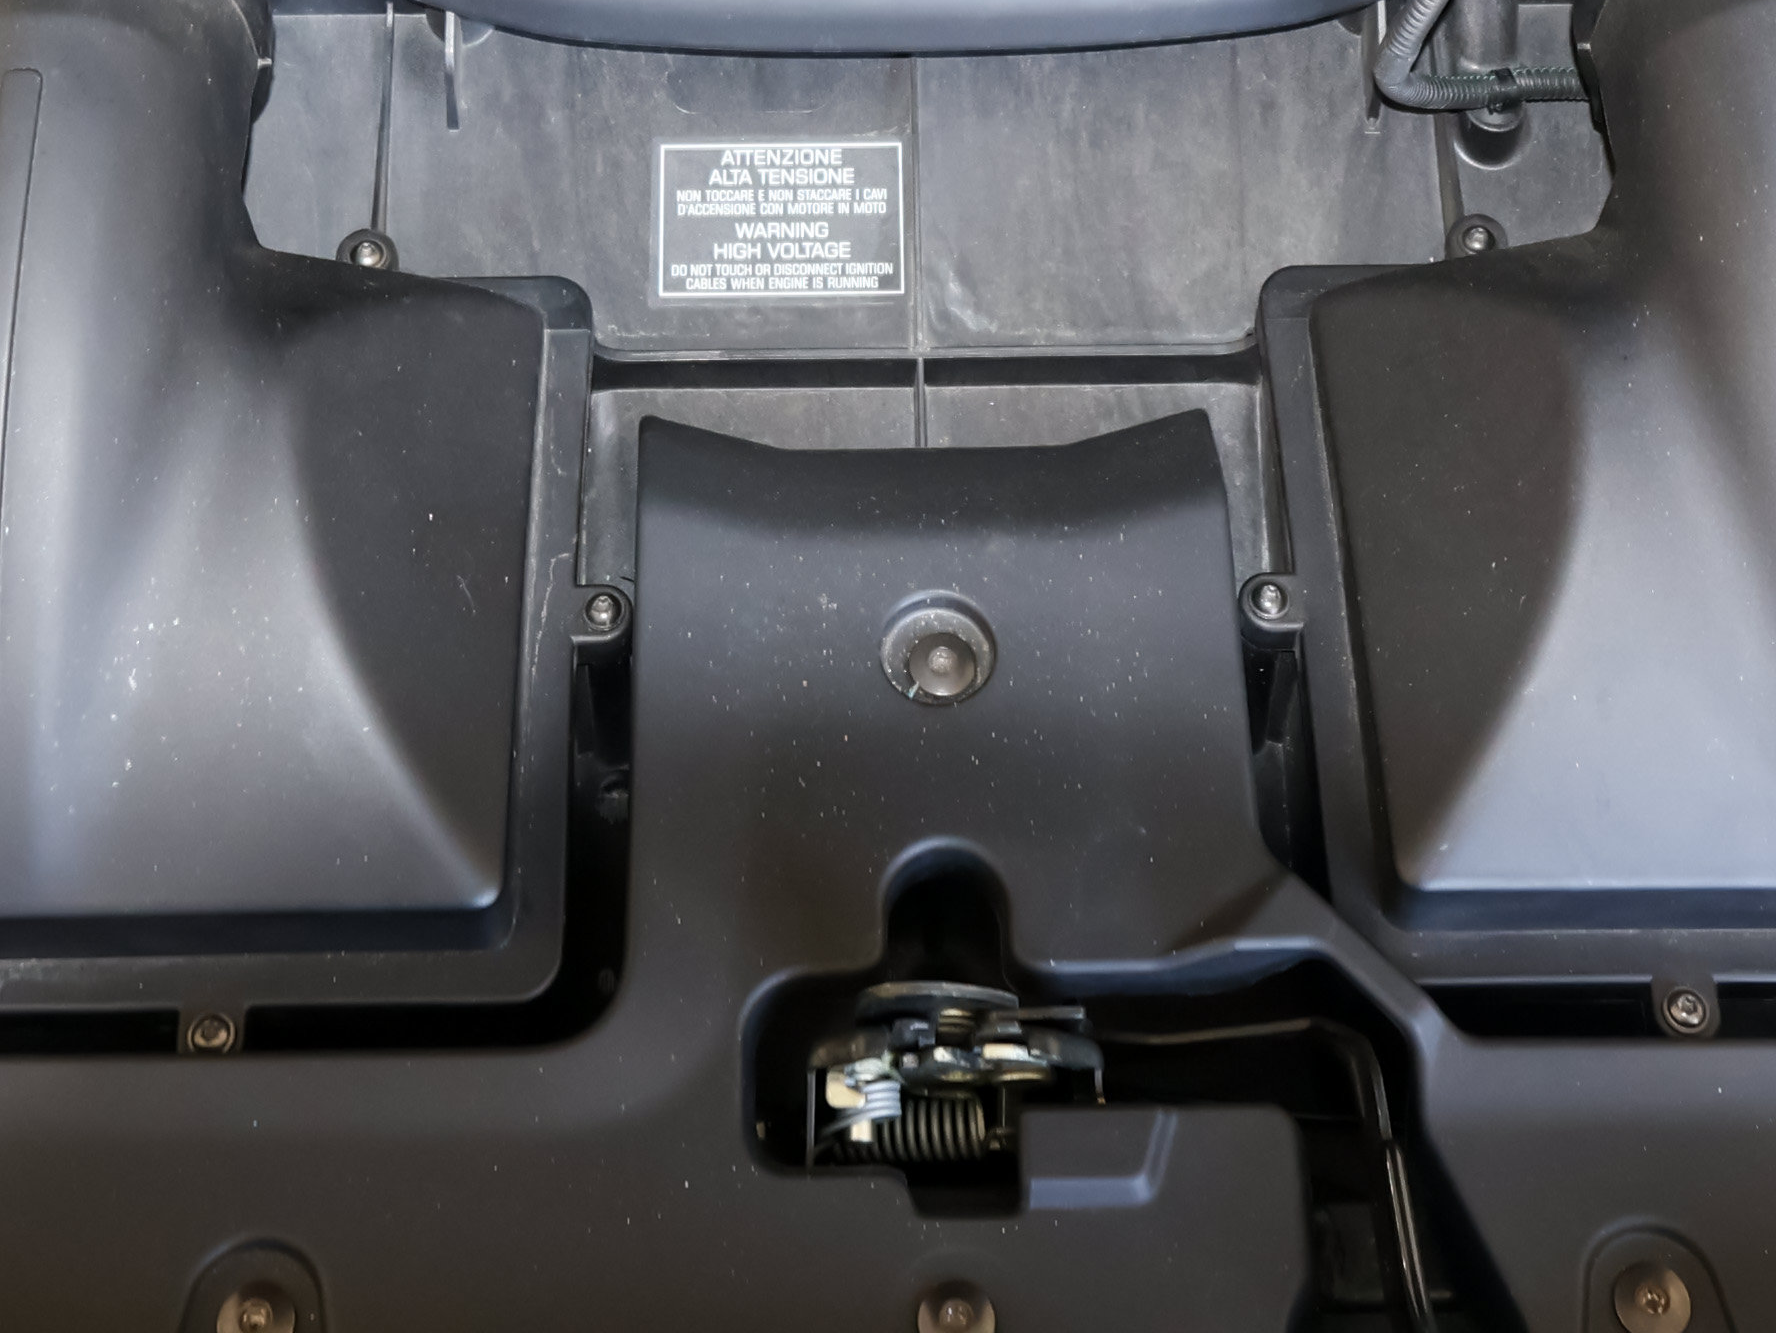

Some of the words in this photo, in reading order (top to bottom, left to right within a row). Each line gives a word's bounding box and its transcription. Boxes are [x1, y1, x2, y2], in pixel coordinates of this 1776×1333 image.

[721, 149, 842, 166] ATTENZIONE
[709, 169, 752, 186] ALTA
[758, 168, 855, 185] TENSIONE
[677, 190, 701, 201] NON
[705, 190, 754, 201] TOCCARE
[759, 190, 765, 201] E
[769, 190, 793, 201] NON
[797, 189, 852, 201] STACCARE
[856, 189, 860, 200] I
[863, 189, 887, 200] CAVI
[677, 203, 756, 216] D'ACCENSIONE
[760, 203, 784, 215] CON
[788, 203, 834, 215] MOTORE
[838, 203, 850, 214] IN
[854, 202, 886, 214] MOTO
[735, 222, 829, 239] WARNING
[714, 243, 761, 260] HIGH
[767, 242, 851, 259] VOLTAGE
[671, 265, 688, 276] DO
[691, 265, 712, 276] NOT
[716, 264, 752, 276] TOUCH
[756, 264, 771, 276] OR
[774, 264, 843, 275] DISCONNECT
[846, 263, 893, 275] IGNITION
[686, 278, 726, 290] CABLES
[731, 278, 765, 289] WHEN
[769, 277, 809, 289] ENGINE
[813, 277, 824, 289] IS
[828, 277, 878, 289] RUNNING
